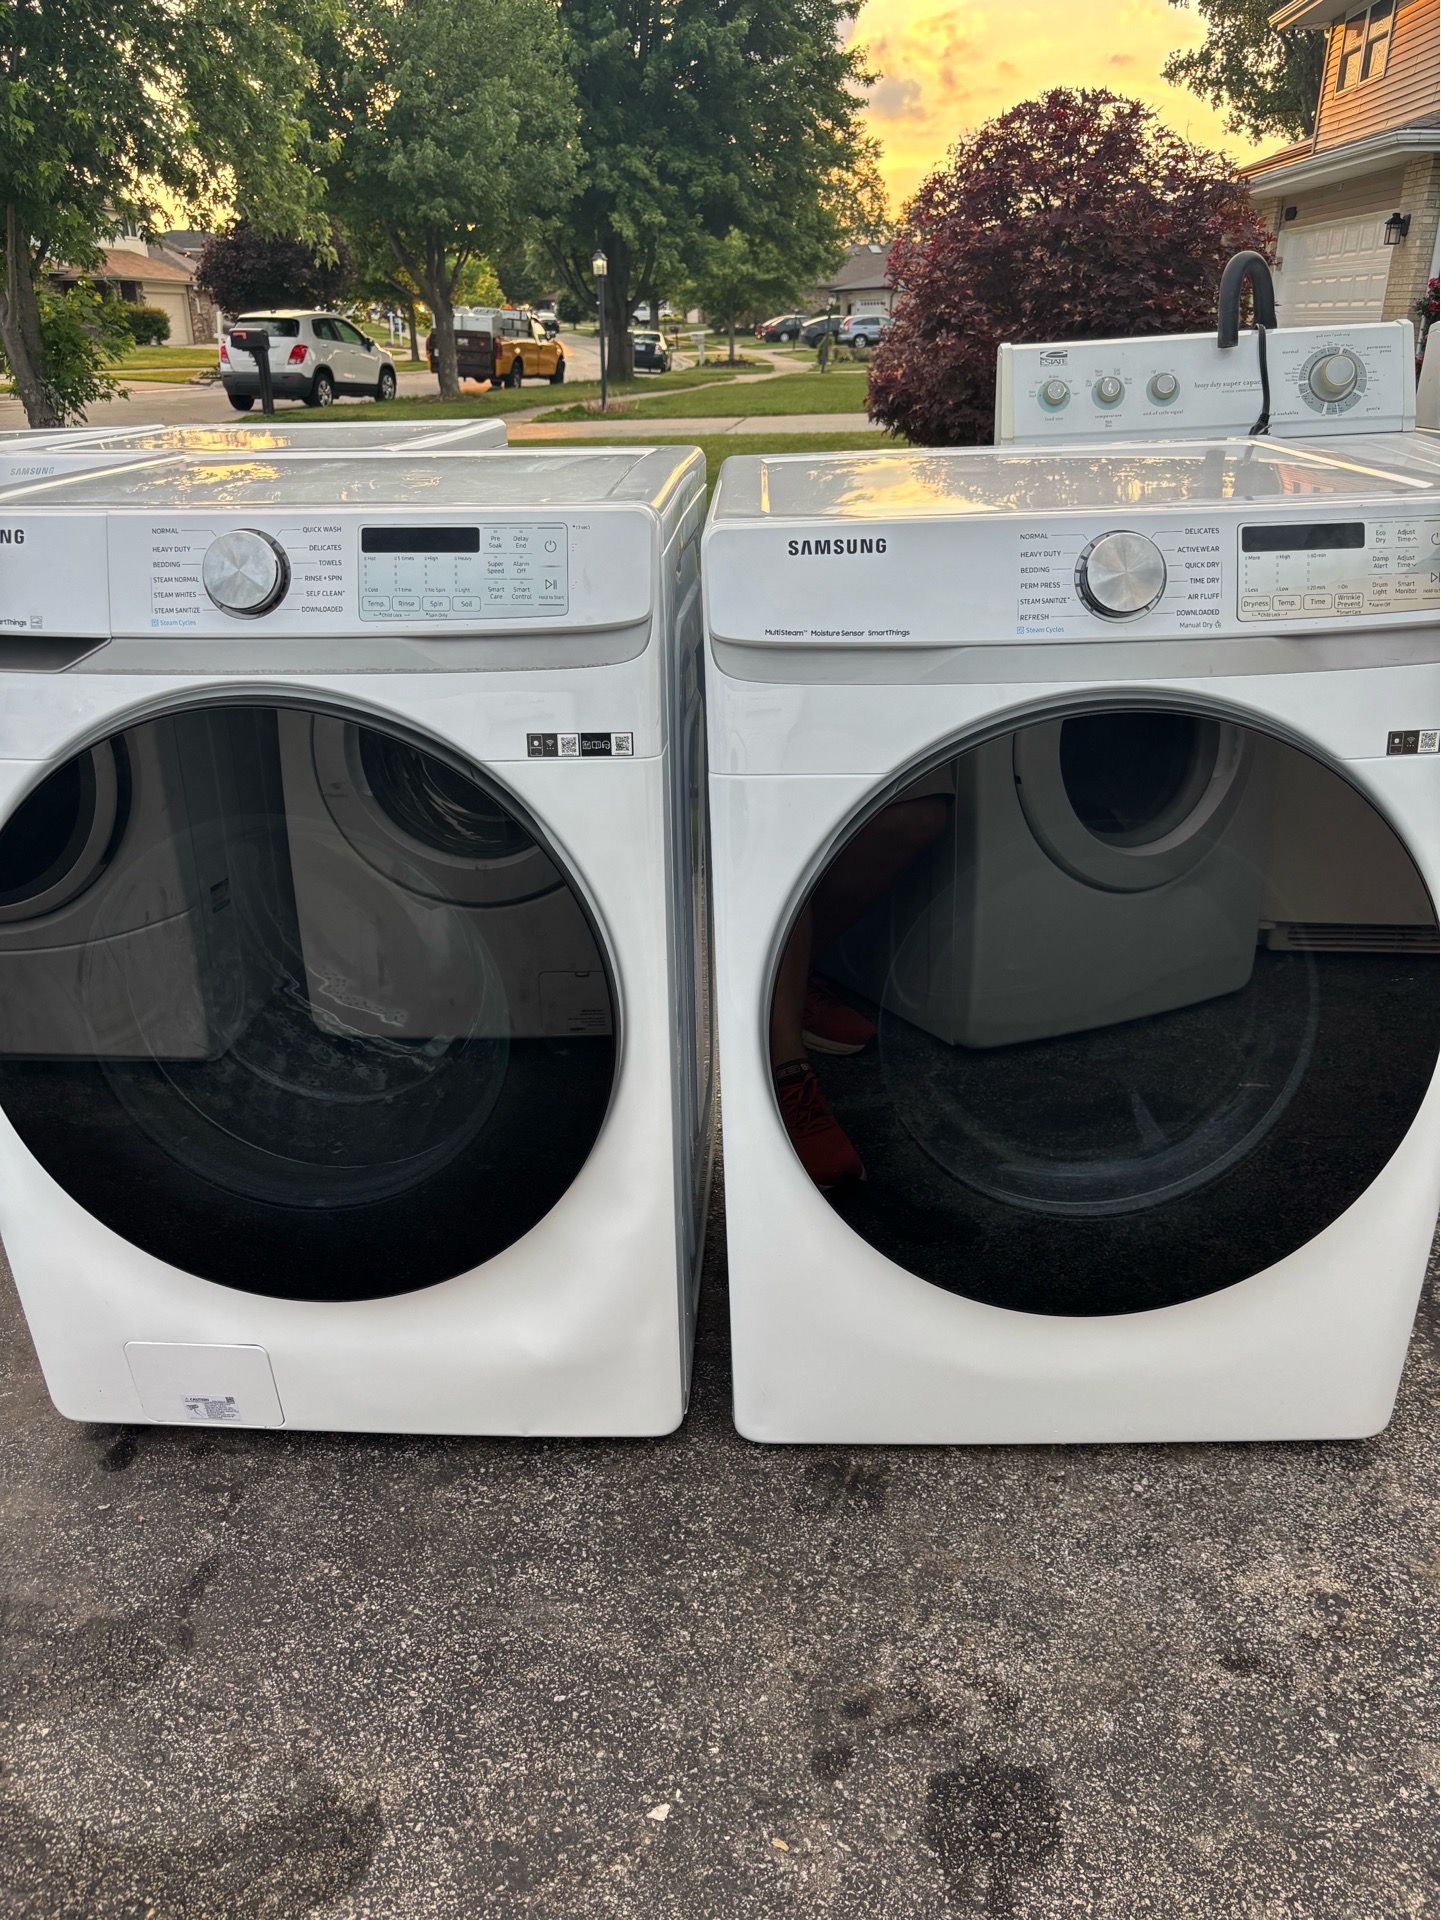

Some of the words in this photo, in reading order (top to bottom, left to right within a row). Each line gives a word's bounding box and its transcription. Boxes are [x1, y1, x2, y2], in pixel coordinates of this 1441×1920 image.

[1194, 382, 1210, 390] heavy
[1210, 382, 1222, 390] duty
[1222, 381, 1241, 389] super
[1242, 379, 1262, 388] capac
[10, 467, 55, 476] SAMSUNG
[788, 538, 887, 556] SAMSUNG
[1243, 600, 1269, 608] Dryness
[1176, 609, 1220, 617] DOWNLOADED
[868, 629, 910, 638] SmartThings
[1046, 626, 1065, 634] Cycles
